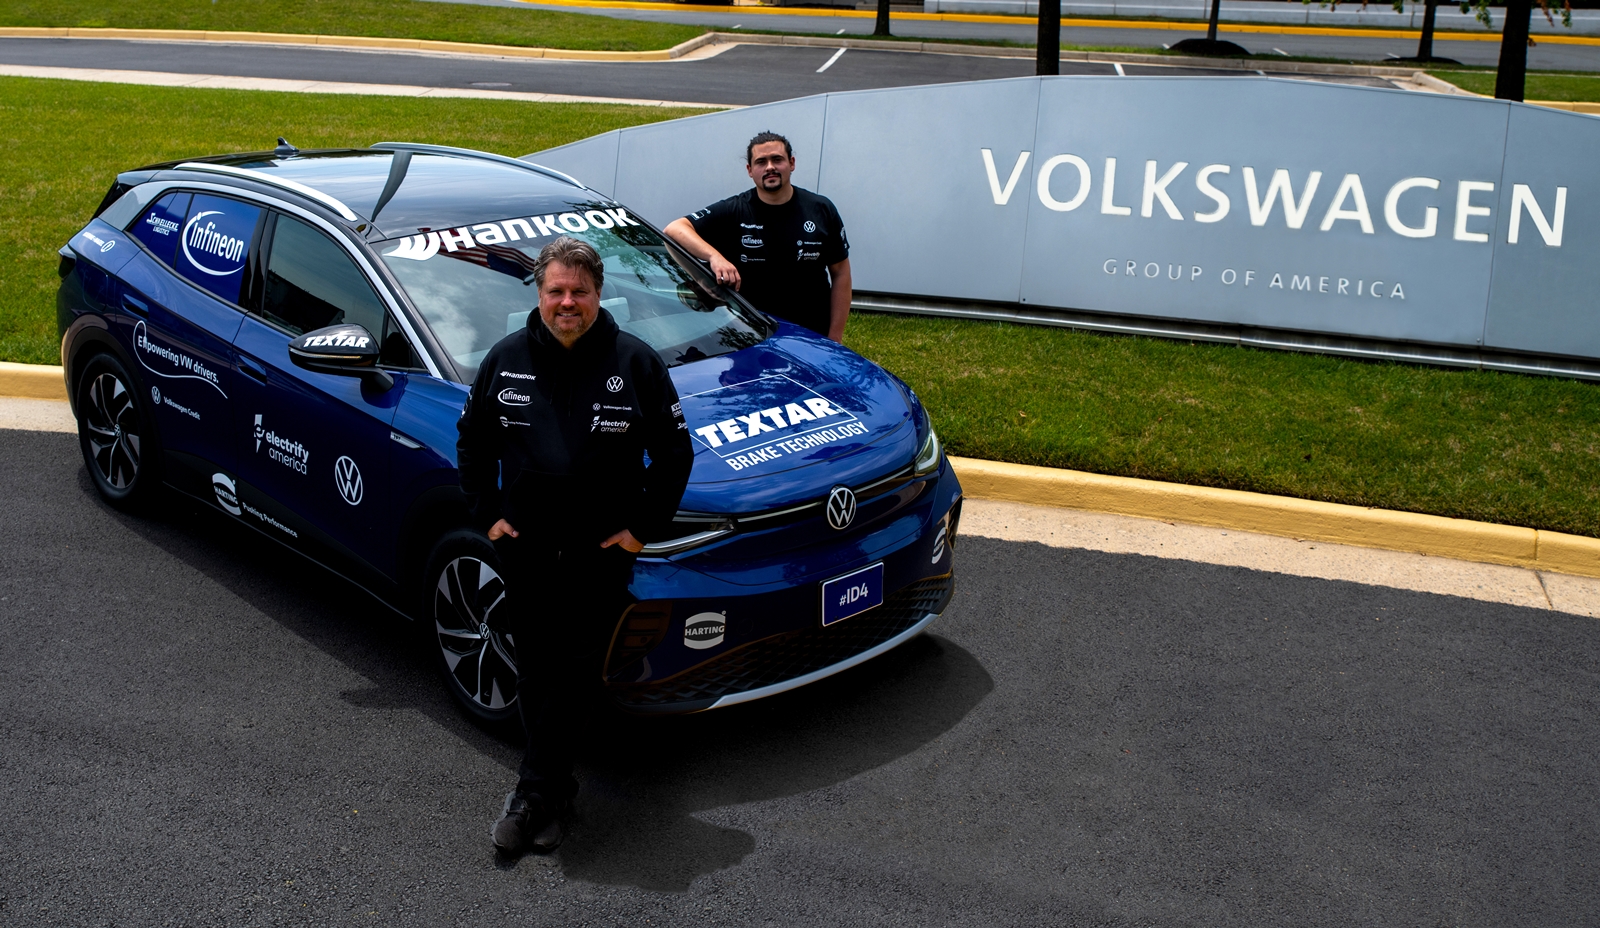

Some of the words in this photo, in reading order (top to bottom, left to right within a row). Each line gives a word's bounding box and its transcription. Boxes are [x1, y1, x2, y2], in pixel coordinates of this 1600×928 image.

[980, 147, 1568, 247] VOLKSWAGEN
[189, 220, 245, 262] Infineon
[1103, 258, 1203, 282] GROUP
[1221, 268, 1256, 287] OF
[1269, 273, 1406, 300] AMERICA
[303, 333, 370, 348] TEXTAR
[179, 353, 194, 370] VW
[193, 361, 219, 384] drivers.
[502, 390, 531, 402] Infineon
[600, 419, 631, 429] electrify
[695, 397, 840, 448] TEXTAR
[265, 430, 310, 464] electrify
[268, 447, 308, 475] america
[725, 445, 783, 471] BRAKE
[776, 421, 870, 452] TECHNOLOGY
[839, 582, 869, 607] #ID4
[684, 625, 725, 636] HARTING
